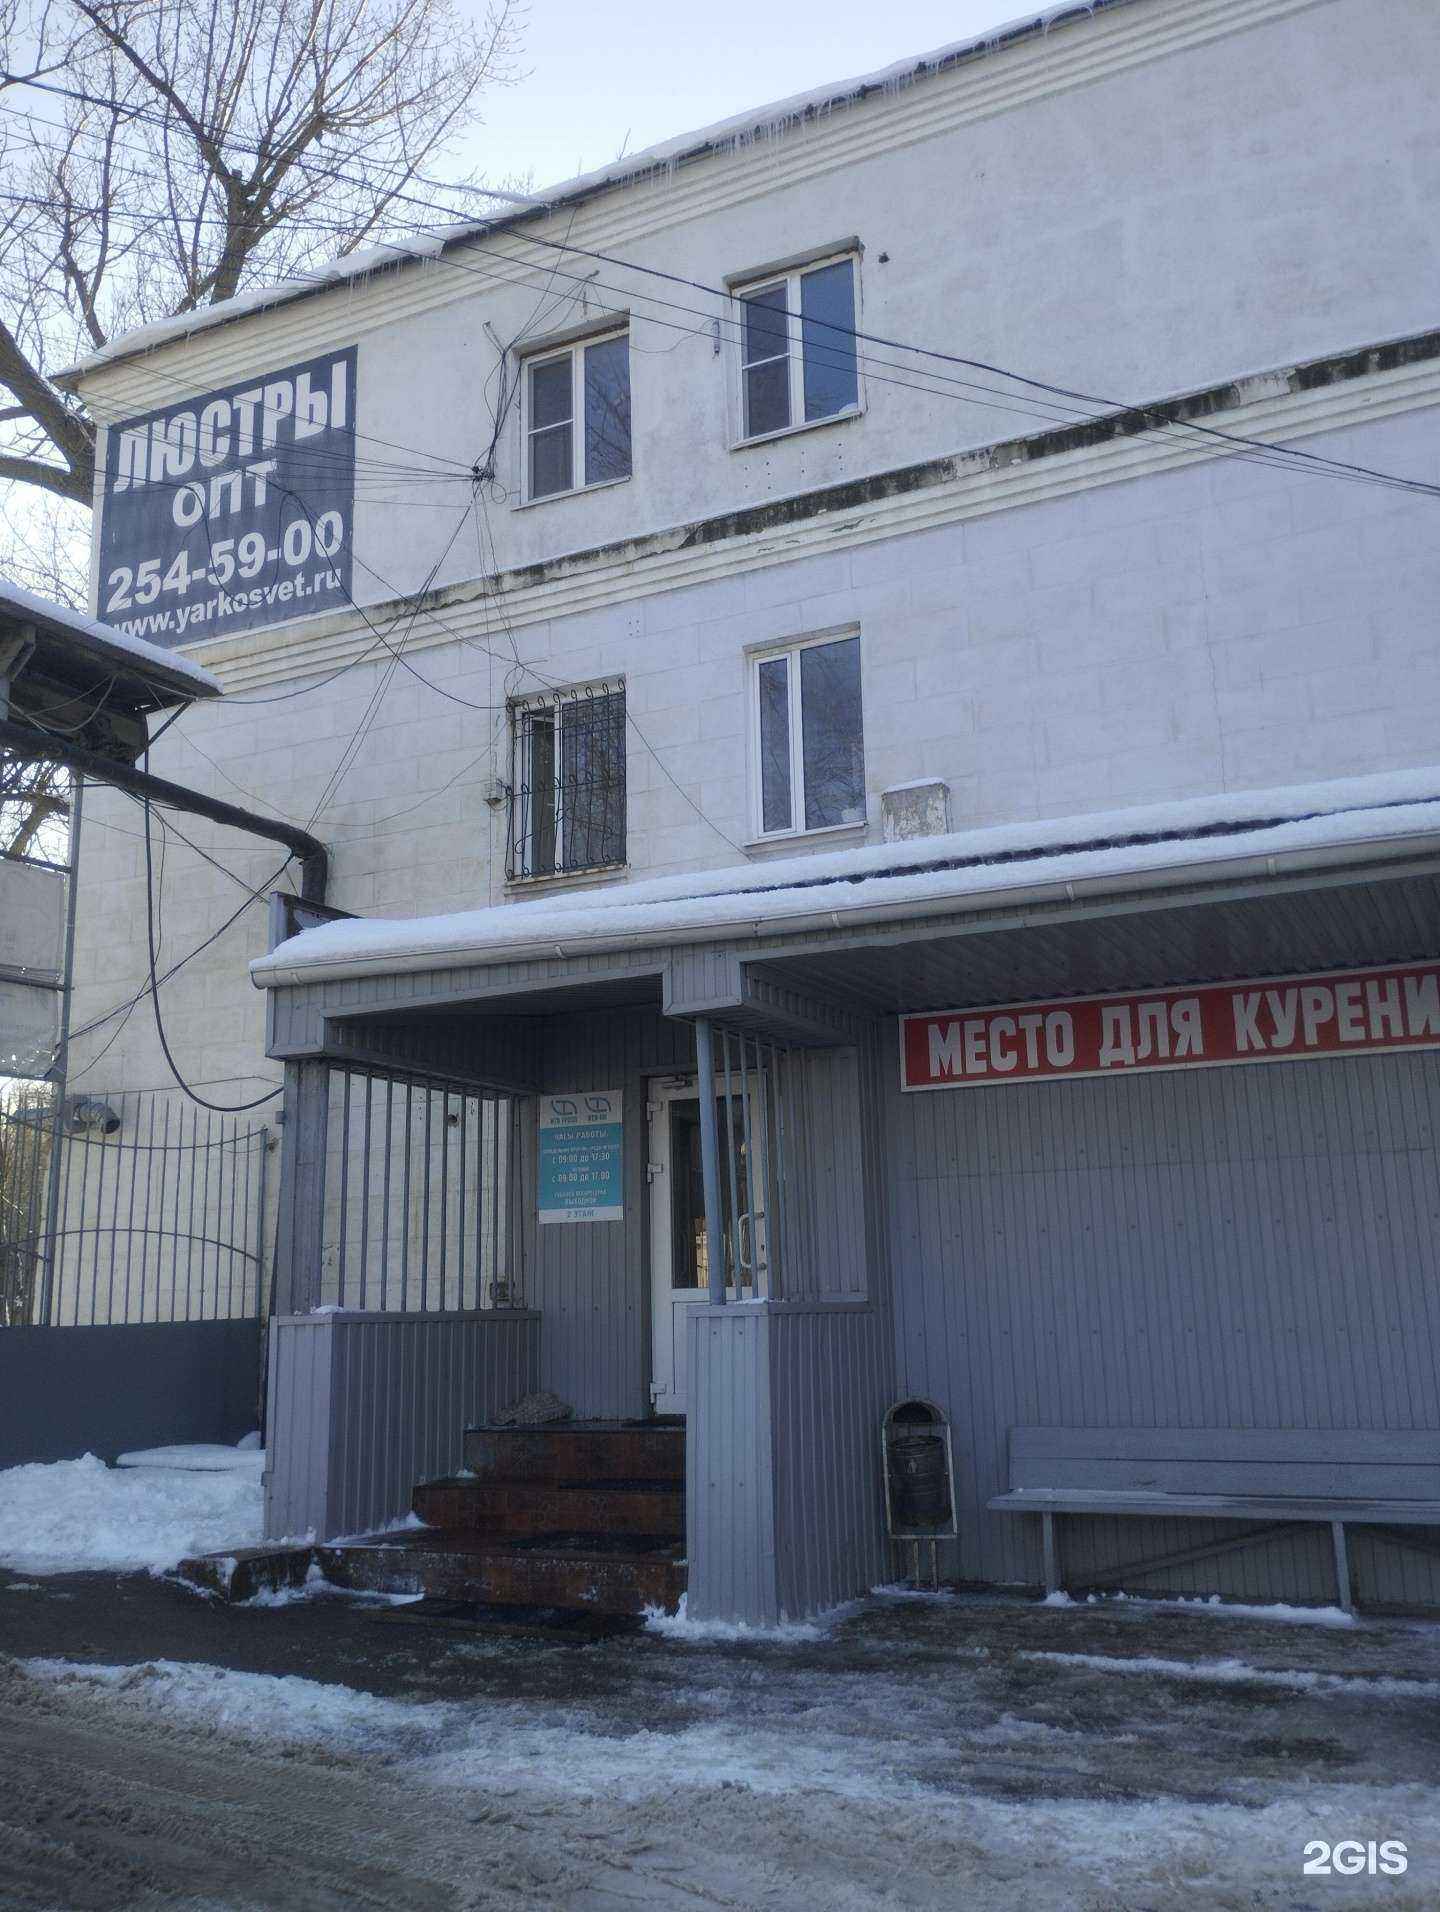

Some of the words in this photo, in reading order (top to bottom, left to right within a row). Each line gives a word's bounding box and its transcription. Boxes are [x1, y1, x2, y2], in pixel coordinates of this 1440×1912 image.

[112, 360, 348, 493] ЛЮСТРЫ
[172, 460, 278, 527] ОПТ
[106, 511, 344, 613] 254-59-00
[112, 569, 341, 637] www.yarkosvet.ru
[926, 1011, 1075, 1078] МЕСТО
[1098, 999, 1206, 1068] ДЛЯ
[591, 1152, 610, 1161] 17:30
